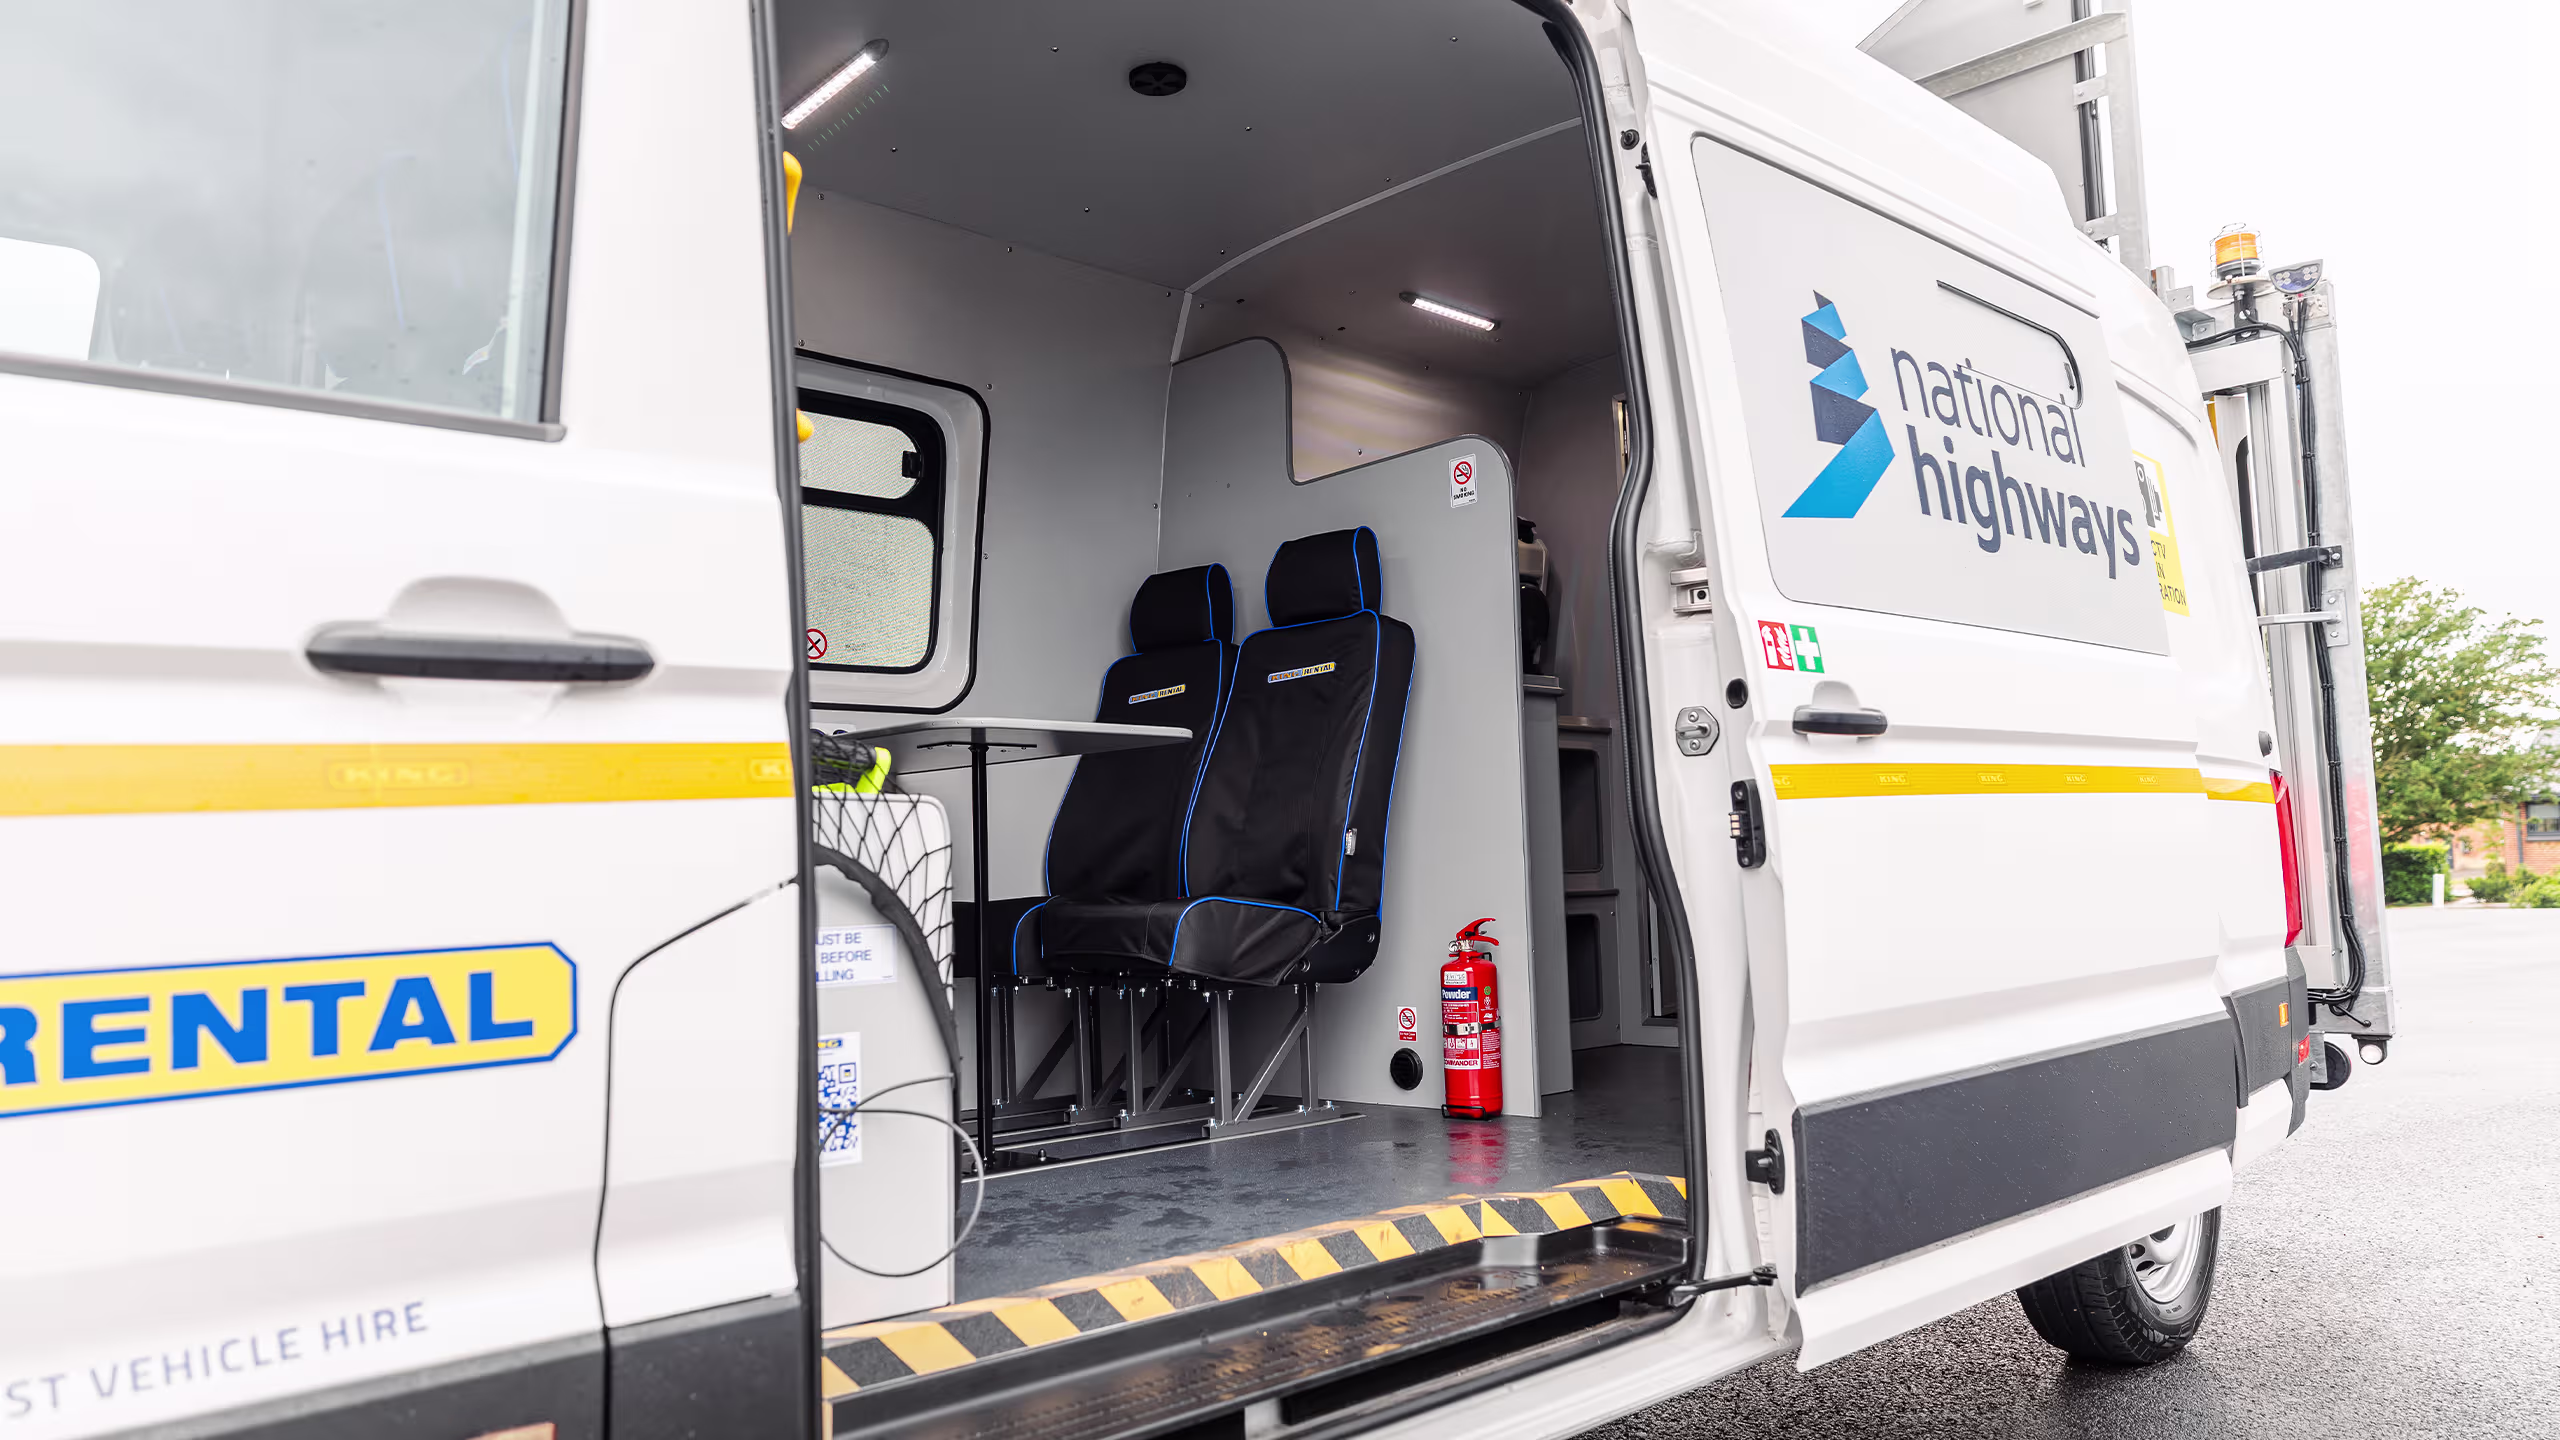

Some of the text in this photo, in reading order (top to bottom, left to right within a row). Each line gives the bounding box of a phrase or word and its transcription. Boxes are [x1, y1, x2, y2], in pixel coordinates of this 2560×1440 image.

[1890, 347, 2086, 468] national
[1906, 424, 2140, 579] highways
[1271, 664, 1333, 681] KING RENTAL
[1131, 686, 1184, 702] KING RENTAL
[343, 765, 457, 785] KING
[1879, 775, 1907, 784] KING
[1981, 774, 2004, 782] KING
[2066, 775, 2086, 783] KING
[844, 932, 862, 945] BE
[821, 949, 872, 964] BEFORE
[1442, 989, 1471, 999] Powder
[0, 971, 533, 1085] RENTAL
[5, 1301, 429, 1418] ST VEHICLE HIRE
